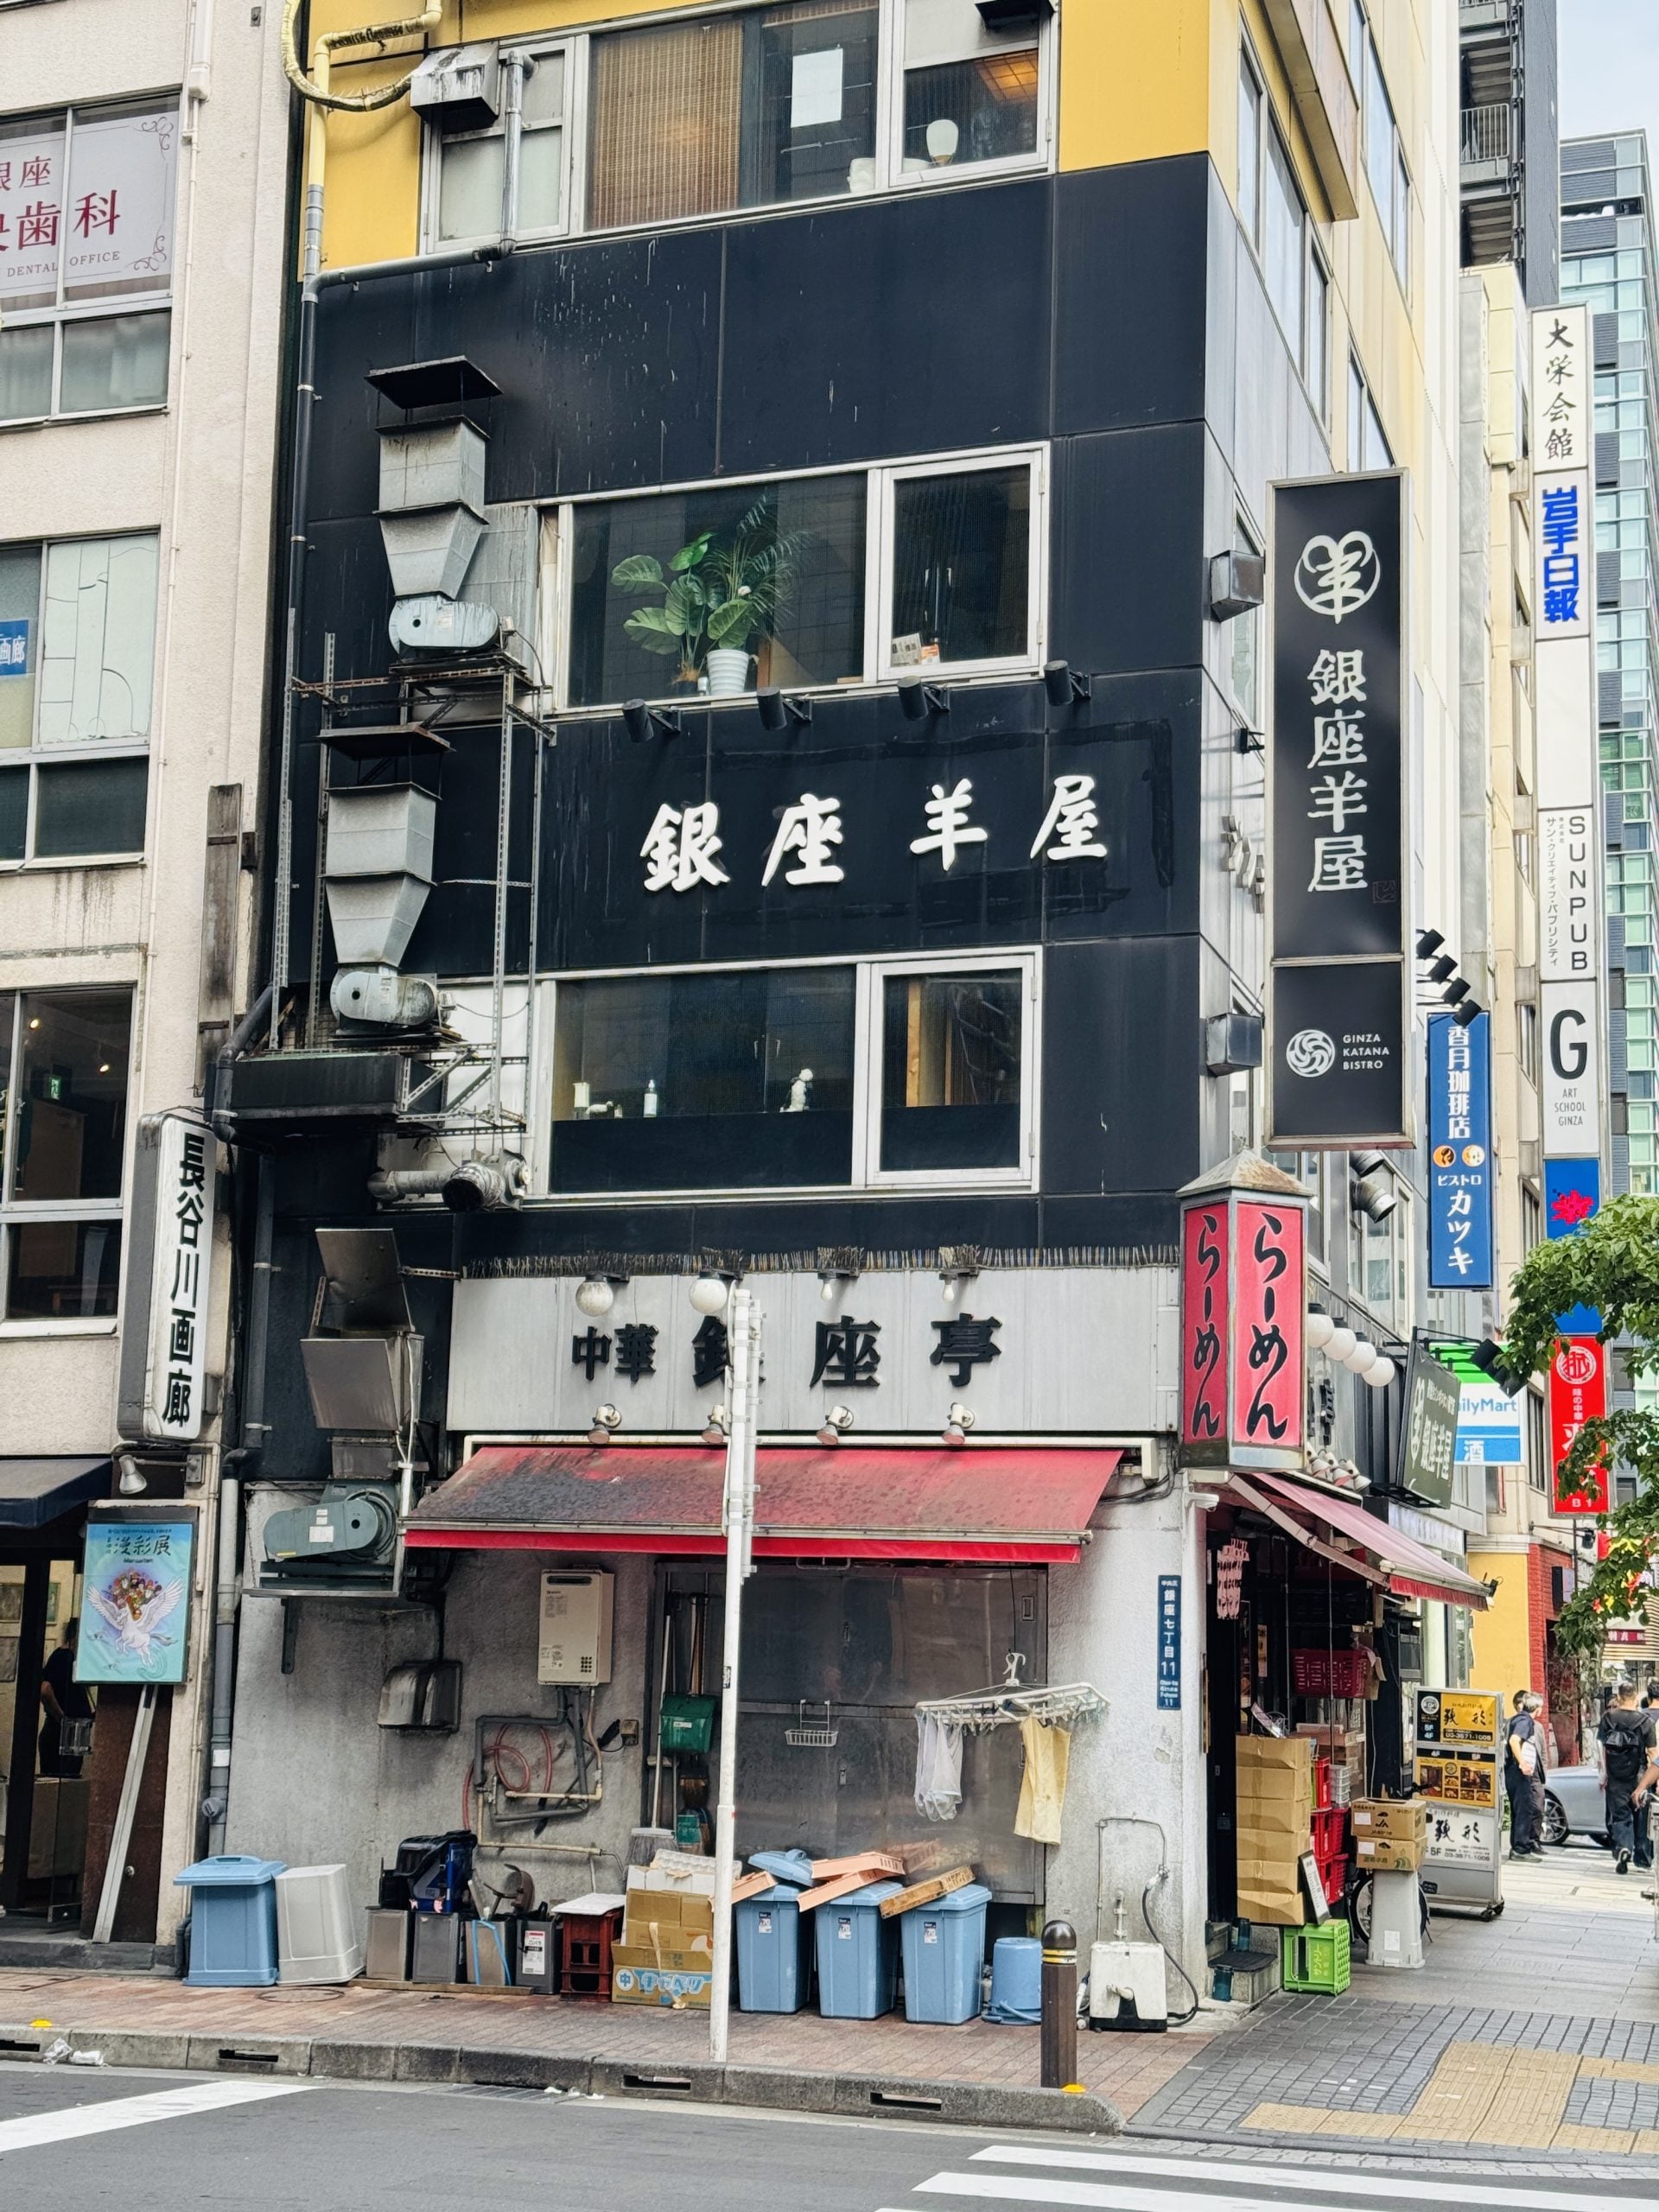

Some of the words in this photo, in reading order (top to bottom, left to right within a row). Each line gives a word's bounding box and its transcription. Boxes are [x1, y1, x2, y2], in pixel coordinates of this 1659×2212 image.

[7, 262, 58, 277] DENTAL
[69, 251, 120, 266] OFFICE
[1542, 318, 1577, 460] 大栄会館
[1542, 485, 1580, 624] 岩手日報
[1306, 649, 1368, 893] 銀座羊屋
[639, 774, 1109, 894] 銀座羊屋
[1569, 816, 1588, 971] SUNPUB
[1343, 1033, 1381, 1044] GINZA
[1343, 1046, 1389, 1057] KATANA
[1343, 1060, 1383, 1071] BISTRO
[1550, 1009, 1588, 1080] G
[1447, 1025, 1471, 1140] 香月珈琲店
[1554, 1102, 1586, 1113] SCHOOL
[1562, 1088, 1578, 1098] ART
[1558, 1116, 1583, 1126] GINZA
[1437, 1174, 1482, 1187] ビストロ
[1447, 1189, 1474, 1275] カツキ
[162, 1132, 205, 1427] 長谷川画廊
[570, 1322, 659, 1384] 中華
[1192, 1214, 1220, 1439] らーめん
[1246, 1212, 1288, 1440] らーめん
[1458, 1397, 1517, 1416] ilyMart
[1463, 1440, 1484, 1462] 酒
[1163, 1589, 1176, 1659] 銀座七丁目
[1160, 1661, 1176, 1676] 11
